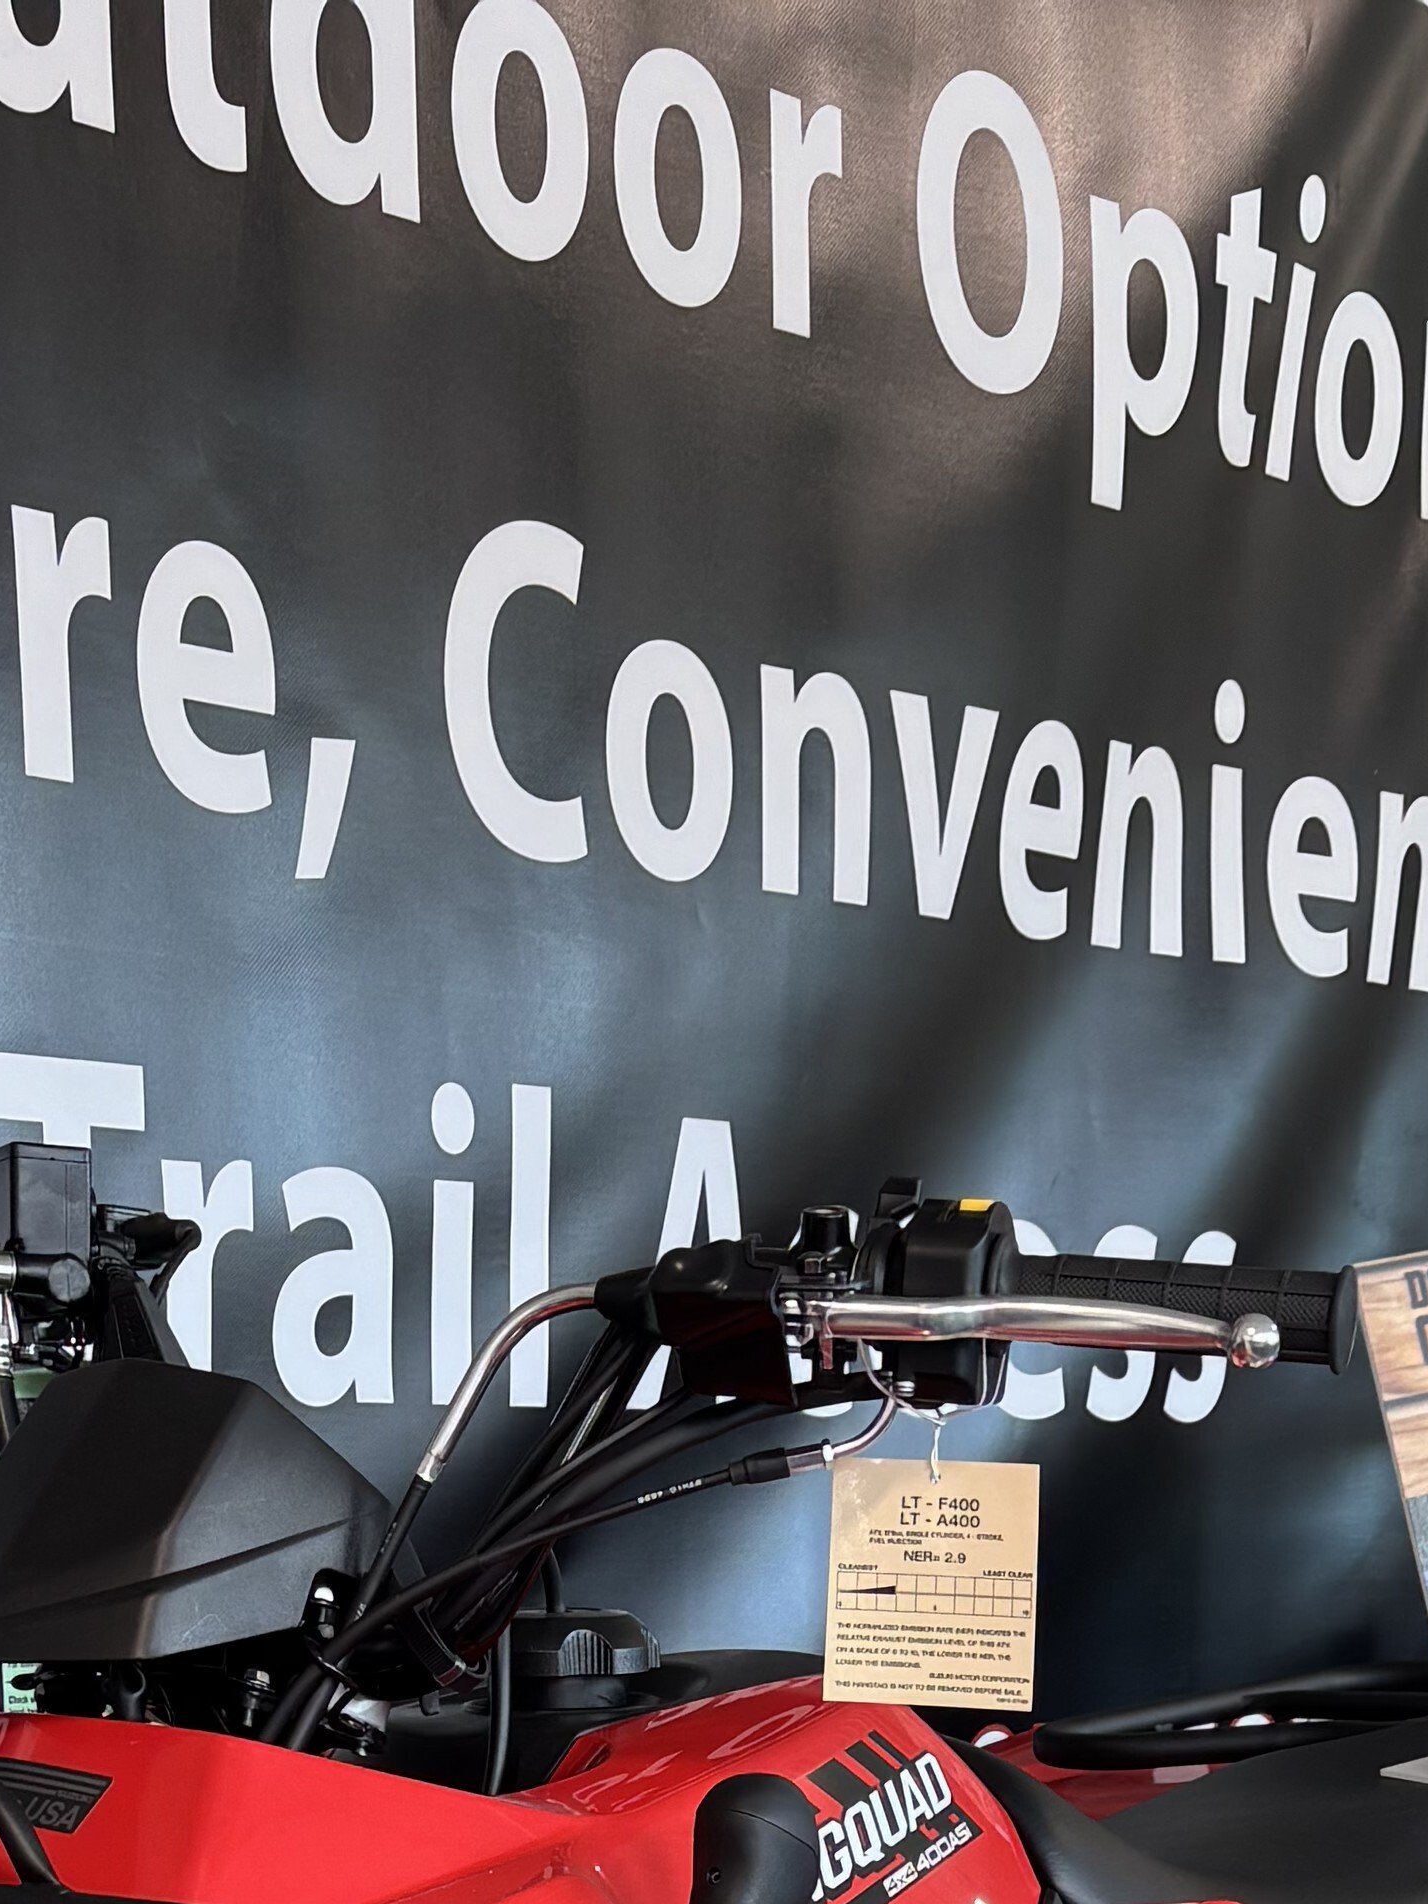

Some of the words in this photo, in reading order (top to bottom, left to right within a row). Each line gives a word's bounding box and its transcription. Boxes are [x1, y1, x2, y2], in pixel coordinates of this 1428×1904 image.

[901, 1496, 921, 1510] LT
[938, 1497, 980, 1512] F400
[900, 1512, 920, 1526] LT
[936, 1514, 981, 1529] A400
[944, 1552, 966, 1564] 2.9
[983, 1570, 1007, 1578] LEAST
[811, 1752, 952, 1902] GQUAD
